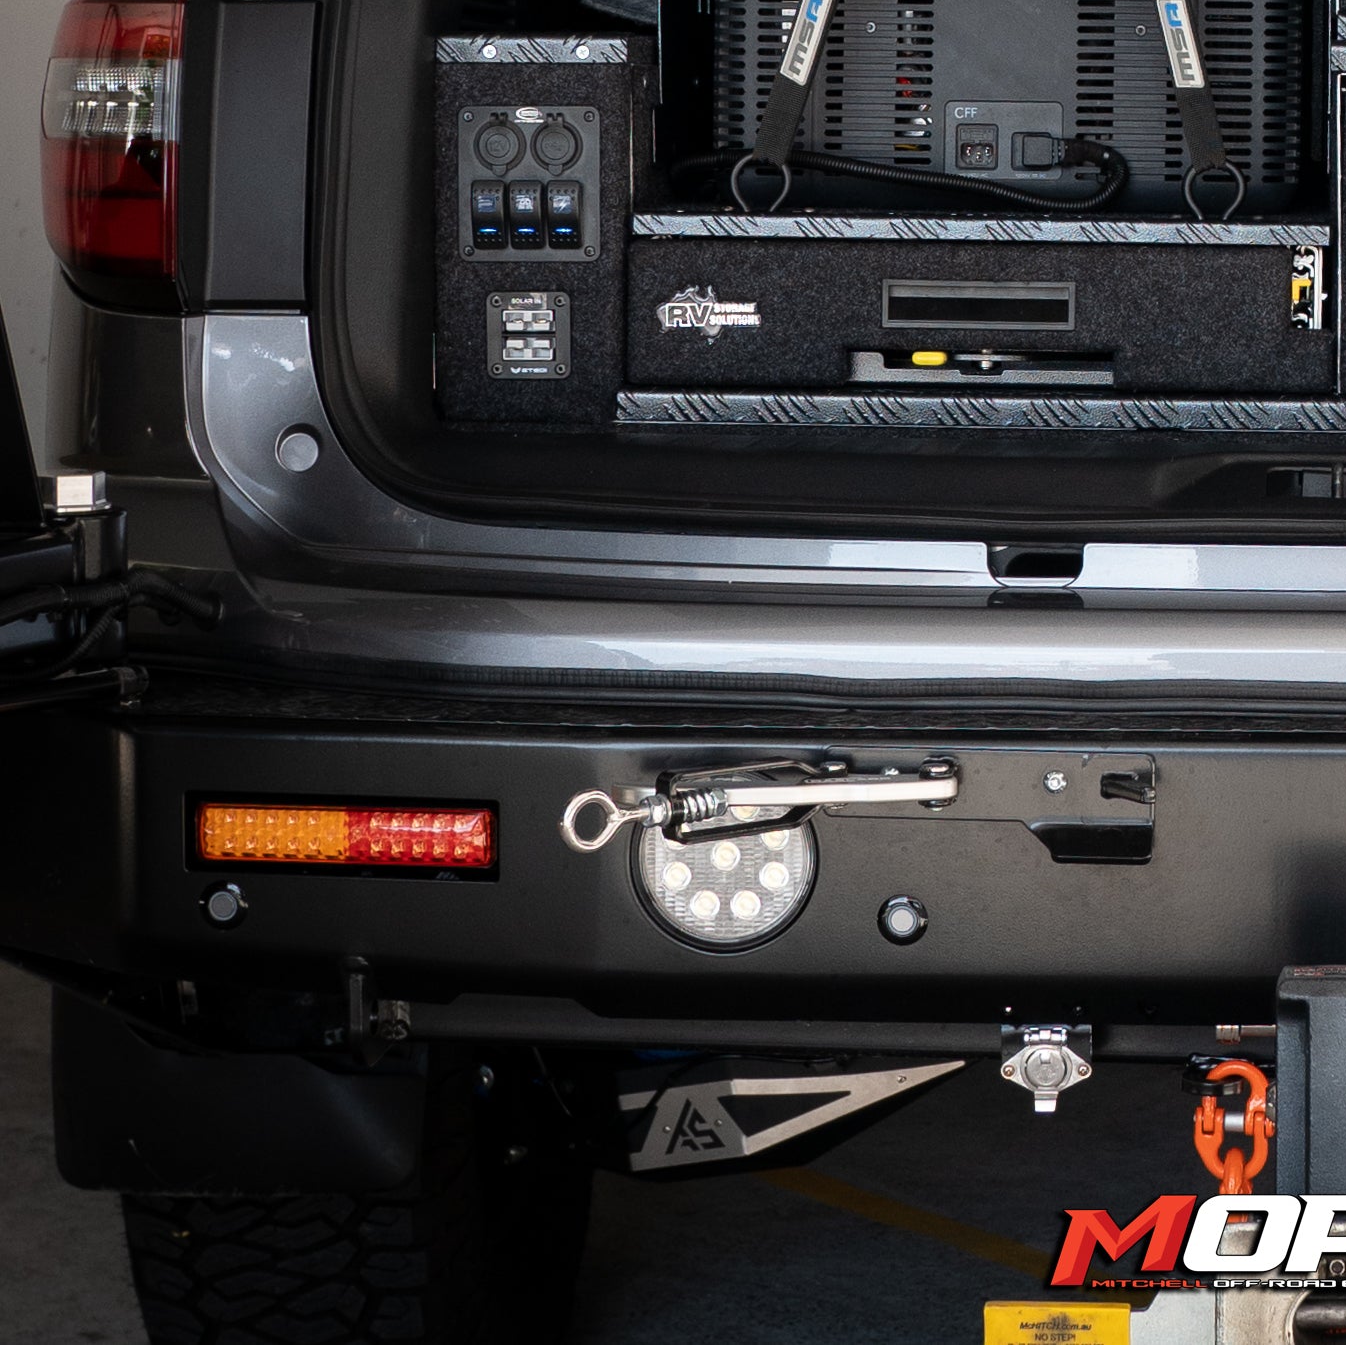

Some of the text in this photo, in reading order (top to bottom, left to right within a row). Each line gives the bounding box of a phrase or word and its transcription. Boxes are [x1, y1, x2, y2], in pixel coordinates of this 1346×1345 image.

[954, 107, 978, 119] CFF
[714, 302, 757, 313] STORAGE
[666, 302, 713, 327] RV
[1035, 1333, 1076, 1342] NO STEP!
